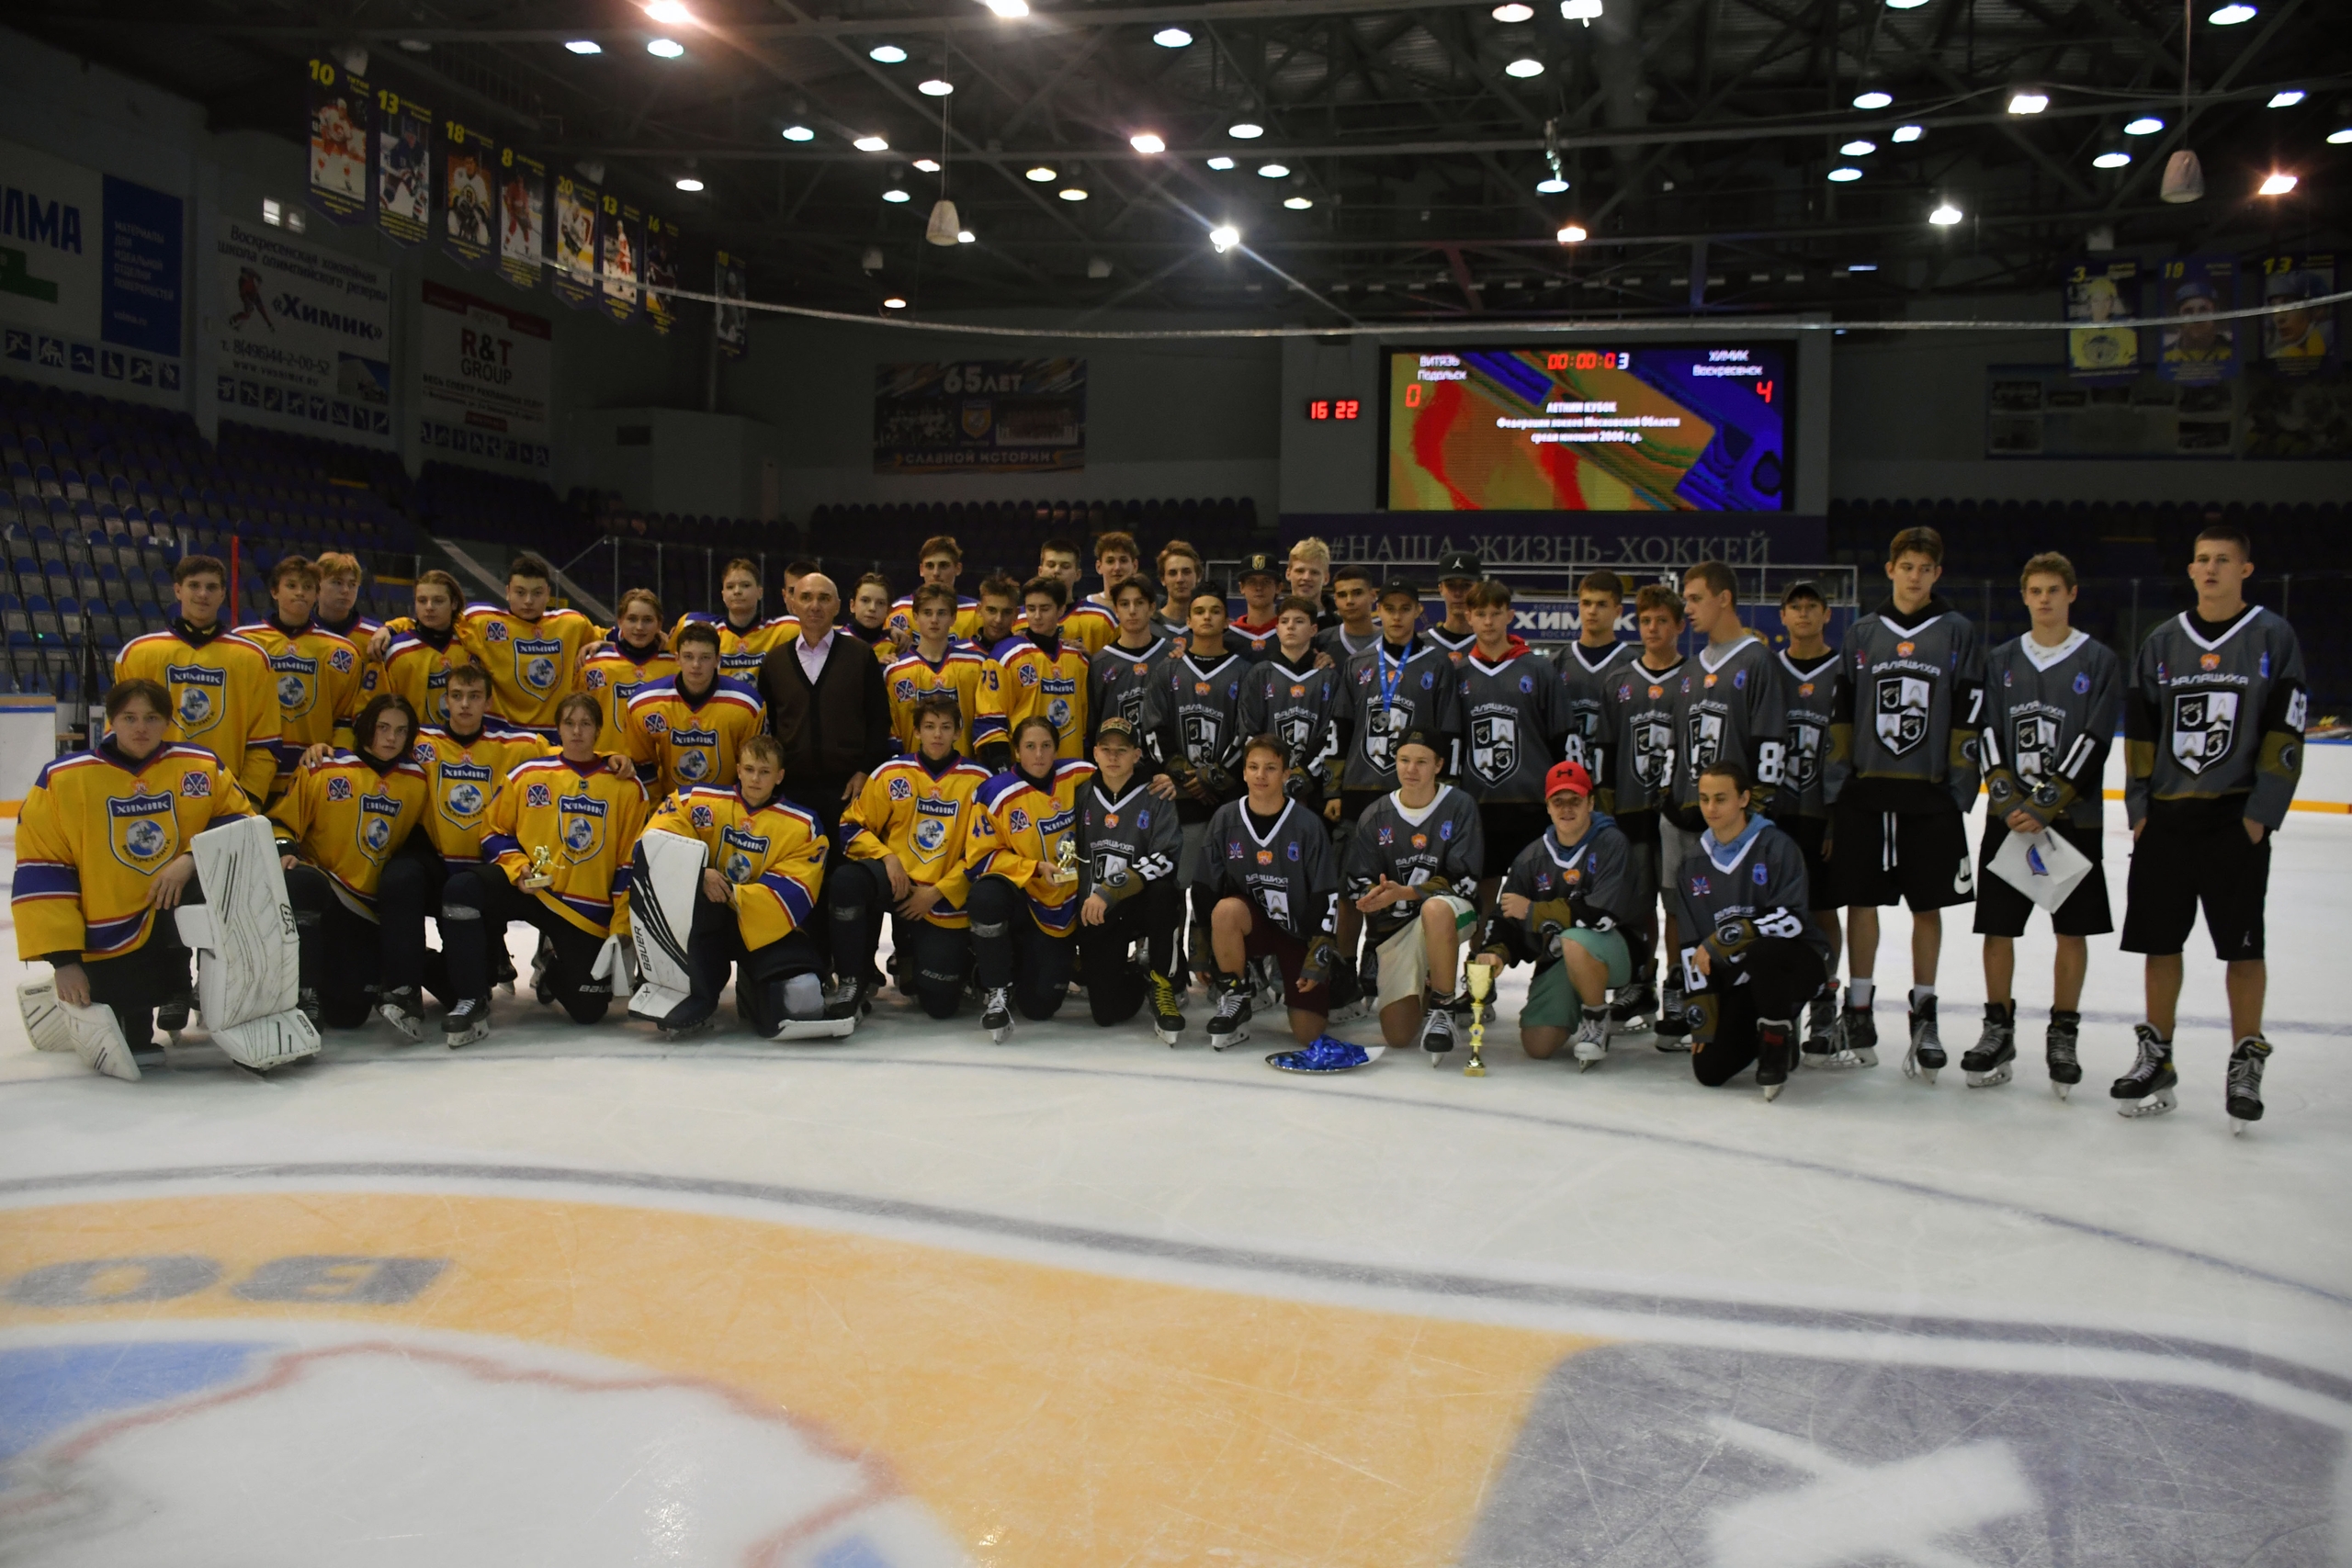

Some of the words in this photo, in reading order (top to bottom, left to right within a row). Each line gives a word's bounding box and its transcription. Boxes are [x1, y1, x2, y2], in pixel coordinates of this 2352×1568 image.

[309, 58, 334, 86] 10
[378, 89, 400, 115] 13
[446, 120, 465, 143] 18
[501, 148, 514, 168] 8
[603, 195, 618, 216] 13
[0, 186, 82, 255] ЛМА
[217, 240, 258, 263] школа
[2263, 256, 2294, 276] 13
[461, 327, 513, 366] R&T
[461, 358, 513, 386] GROUP
[944, 366, 982, 393] 65
[982, 374, 1024, 392] ЛЕТ
[1418, 369, 1467, 381] Подольск
[1692, 364, 1763, 378] Воскресенск
[1405, 384, 1422, 408] 0
[1756, 380, 1773, 404] 4
[1310, 400, 1329, 420] 16
[1335, 400, 1359, 420] 22
[905, 450, 976, 465] СЛАВНОЙ
[1513, 610, 1637, 632] ХИМК
[1871, 659, 1941, 677] БАЛАШИХА
[117, 800, 171, 815] ХИМИК
[634, 925, 652, 972] BAUER
